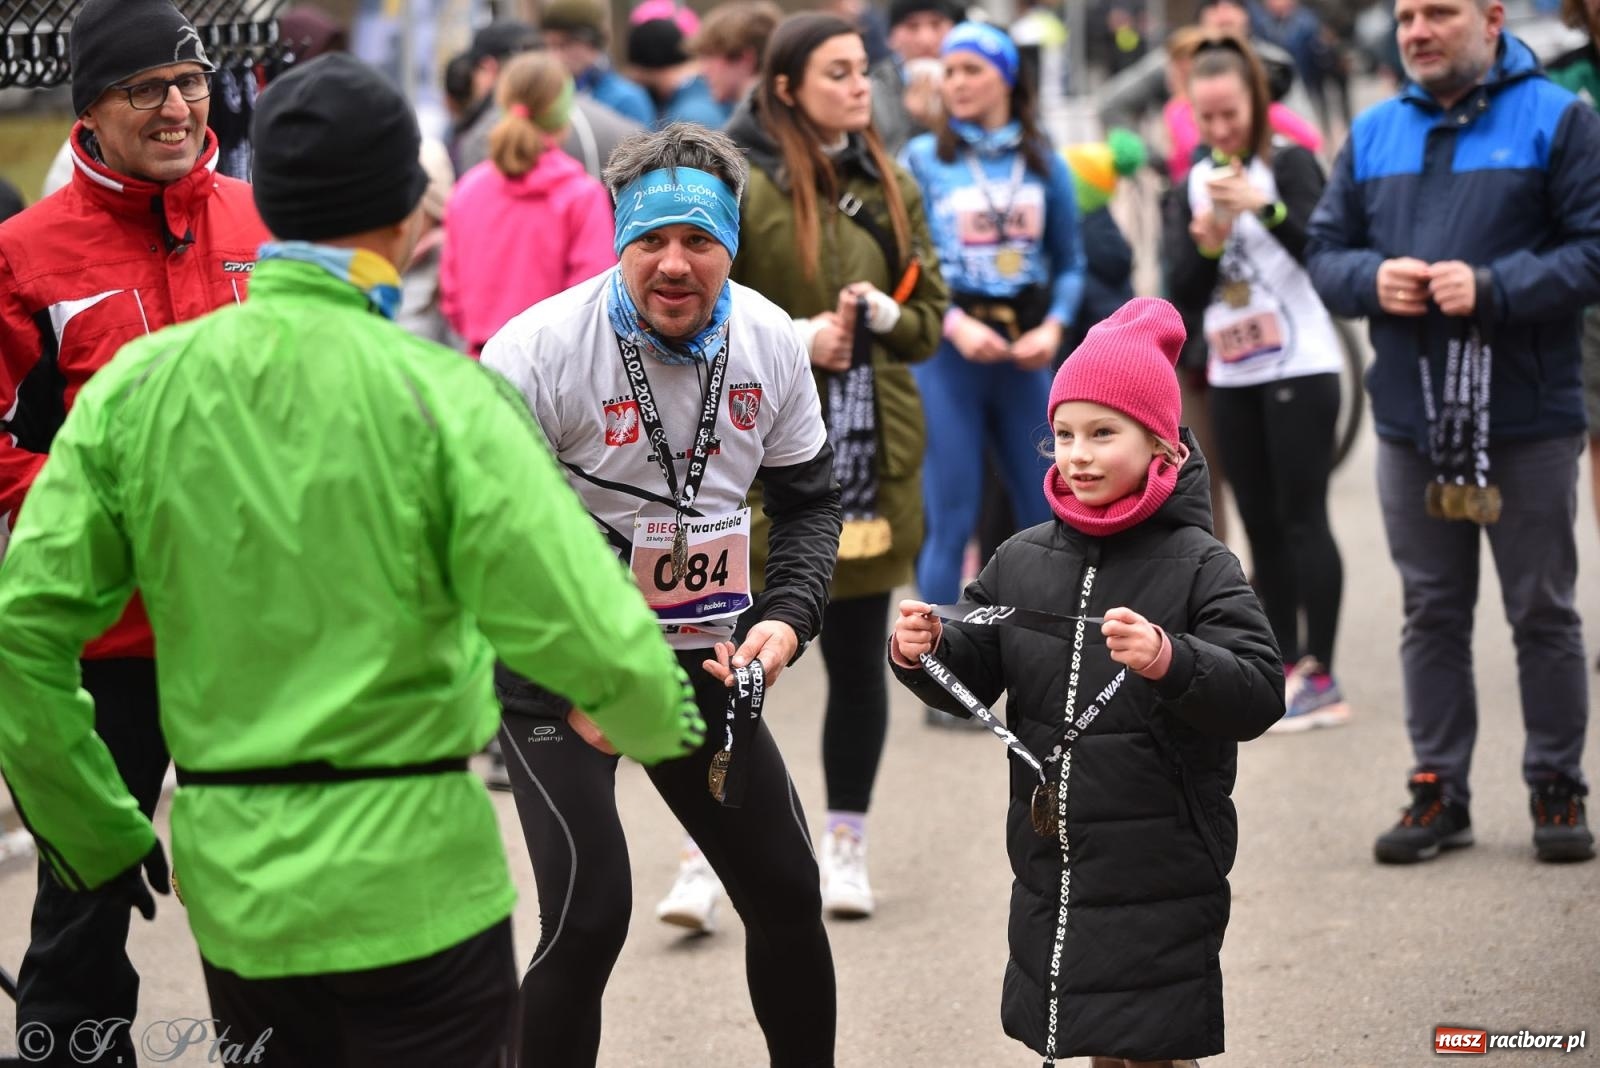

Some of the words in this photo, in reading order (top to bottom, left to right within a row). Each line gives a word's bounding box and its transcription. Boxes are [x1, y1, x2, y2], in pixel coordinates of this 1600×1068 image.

[687, 183, 718, 201] GÓRA
[602, 394, 636, 407] POLSK
[690, 461, 703, 478] 13
[647, 522, 678, 534] BIEG
[683, 515, 742, 534] Twardziela
[653, 548, 729, 592] 084
[1064, 729, 1079, 741] 13
[1075, 704, 1100, 730] BIEG
[1061, 748, 1072, 780] COO
